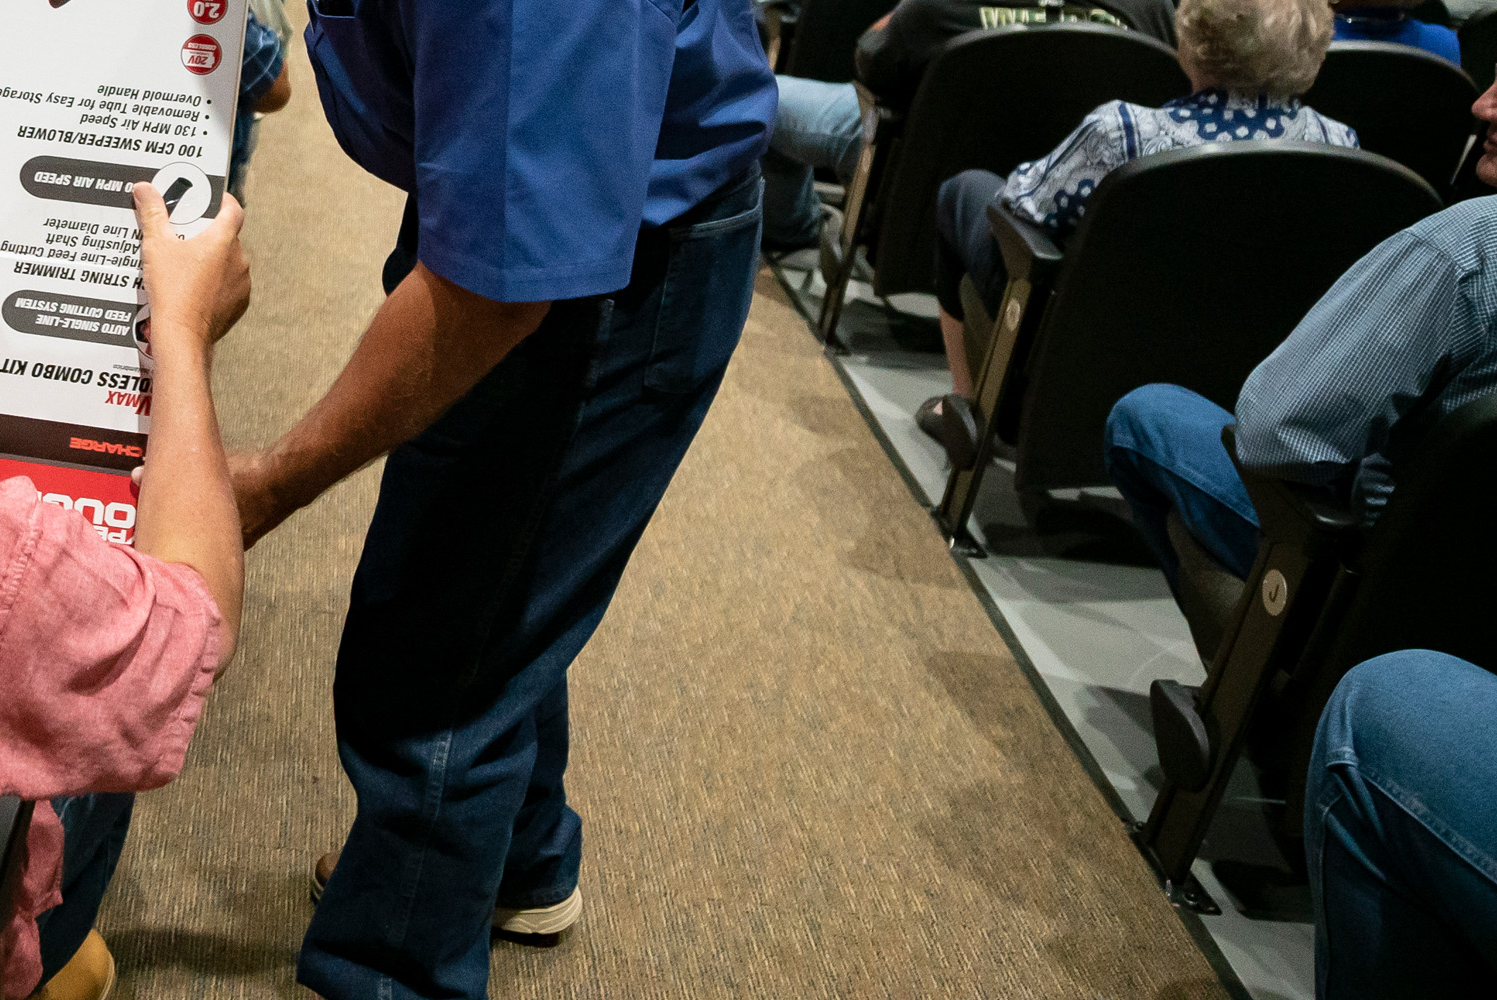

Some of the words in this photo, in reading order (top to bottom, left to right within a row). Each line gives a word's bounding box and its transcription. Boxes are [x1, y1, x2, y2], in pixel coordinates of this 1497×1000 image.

[193, 1, 221, 19] 2.0
[188, 55, 208, 66] 20V
[46, 92, 75, 108] Easy
[97, 85, 141, 100] Handle
[142, 89, 202, 106] Overmold
[78, 98, 96, 110] for
[99, 101, 128, 114] Tube
[132, 104, 201, 122] Removable
[80, 113, 118, 129] Speed
[121, 119, 140, 130] Air
[142, 121, 172, 135] MPH
[17, 125, 143, 151] SWEEPER/BLOWER
[174, 125, 197, 137] 130
[145, 140, 175, 156] CFM
[178, 144, 203, 158] 100
[34, 171, 72, 186] SPEED
[73, 175, 96, 189] AIR
[94, 177, 123, 192] MPH
[42, 218, 100, 235] Diameter
[103, 224, 129, 238] Line
[46, 233, 79, 247] Shaft
[82, 235, 142, 255] Adjusting
[0, 240, 44, 257] Cutting
[47, 249, 77, 262] Feed
[80, 250, 144, 271] ingle-Line
[14, 261, 77, 281] TRIMMER
[80, 269, 130, 288] STRING
[14, 297, 59, 312] SYSTEM
[60, 303, 103, 318] CUTTING
[105, 308, 132, 321] FEED
[35, 314, 100, 332] SINGLE-LINE
[101, 322, 131, 336] AUTO
[0, 358, 29, 376] KIT
[31, 362, 94, 385] COMBO
[97, 371, 152, 393] DLESS
[69, 436, 143, 458] CHARGE
